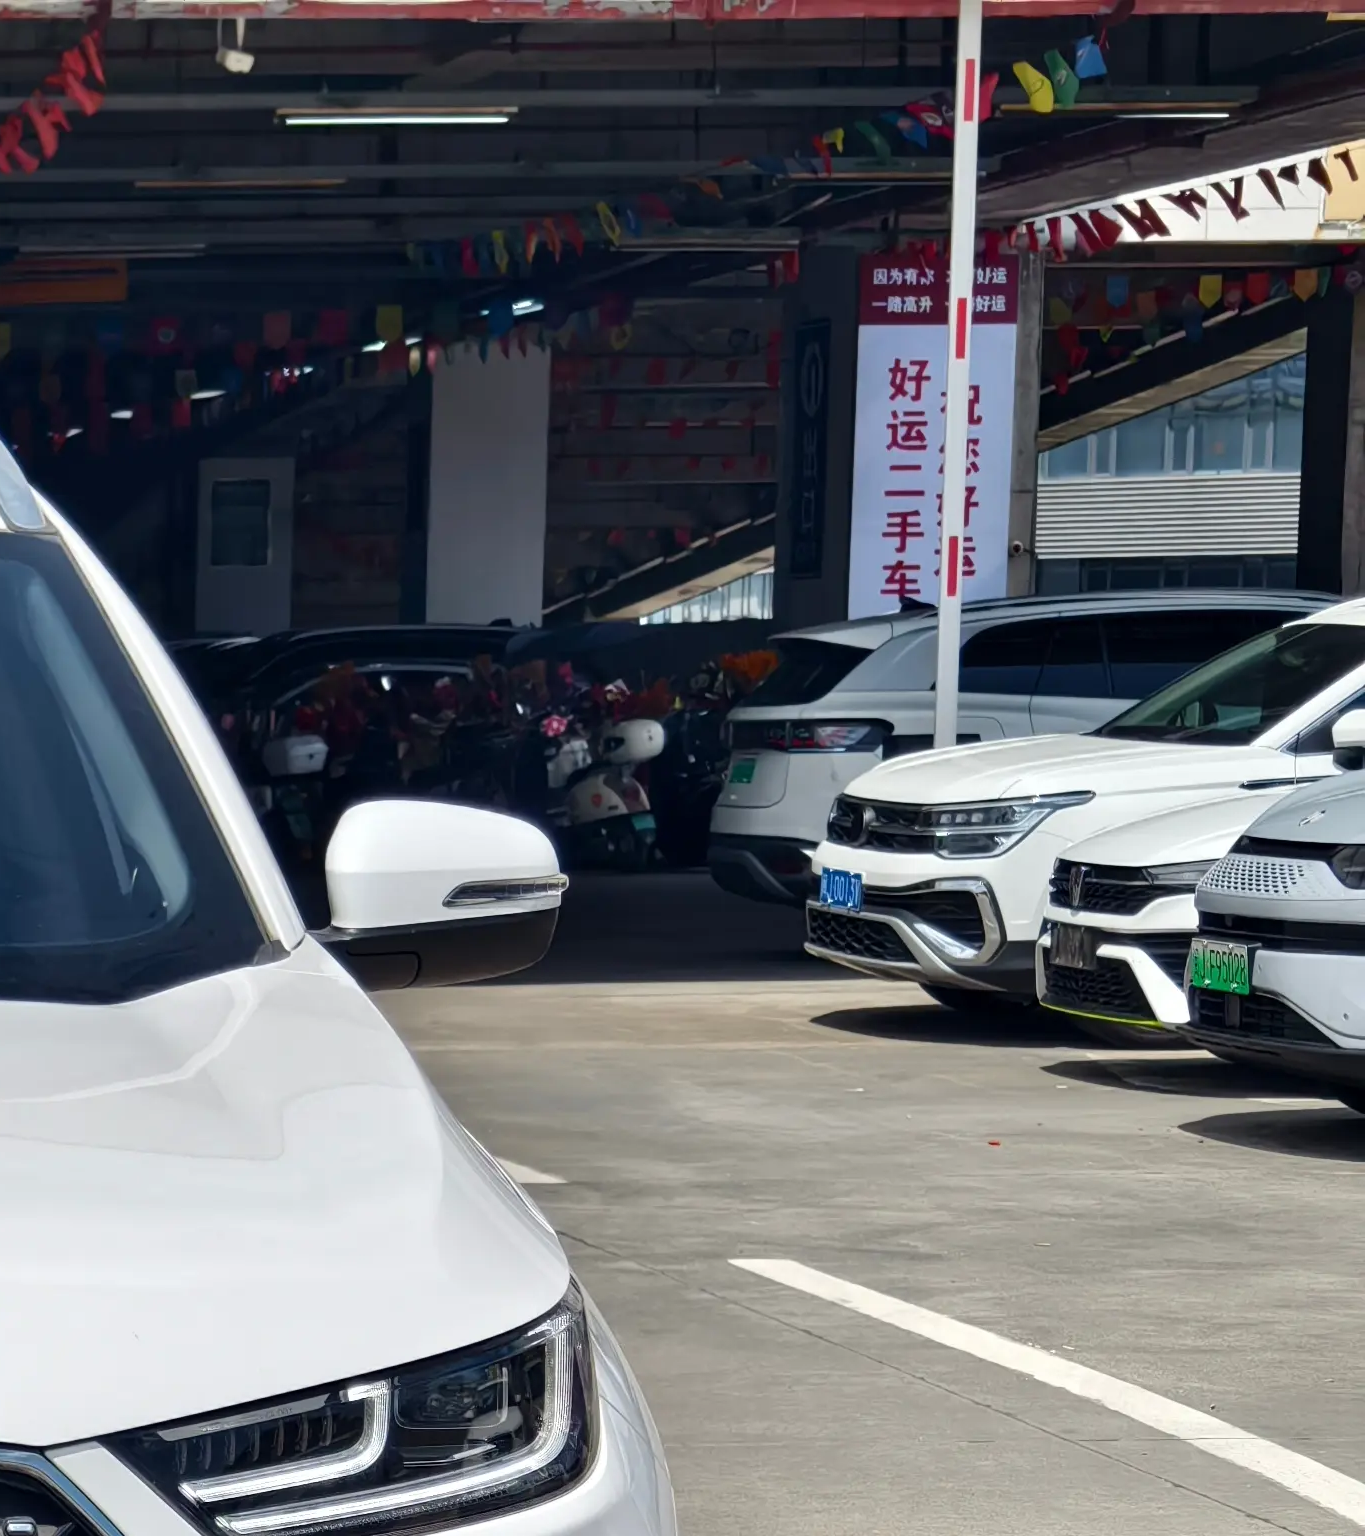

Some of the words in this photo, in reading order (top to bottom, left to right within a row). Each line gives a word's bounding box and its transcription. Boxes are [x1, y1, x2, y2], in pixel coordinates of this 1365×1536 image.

[872, 296, 933, 313] 一路高升
[880, 358, 931, 598] 好运二手车
